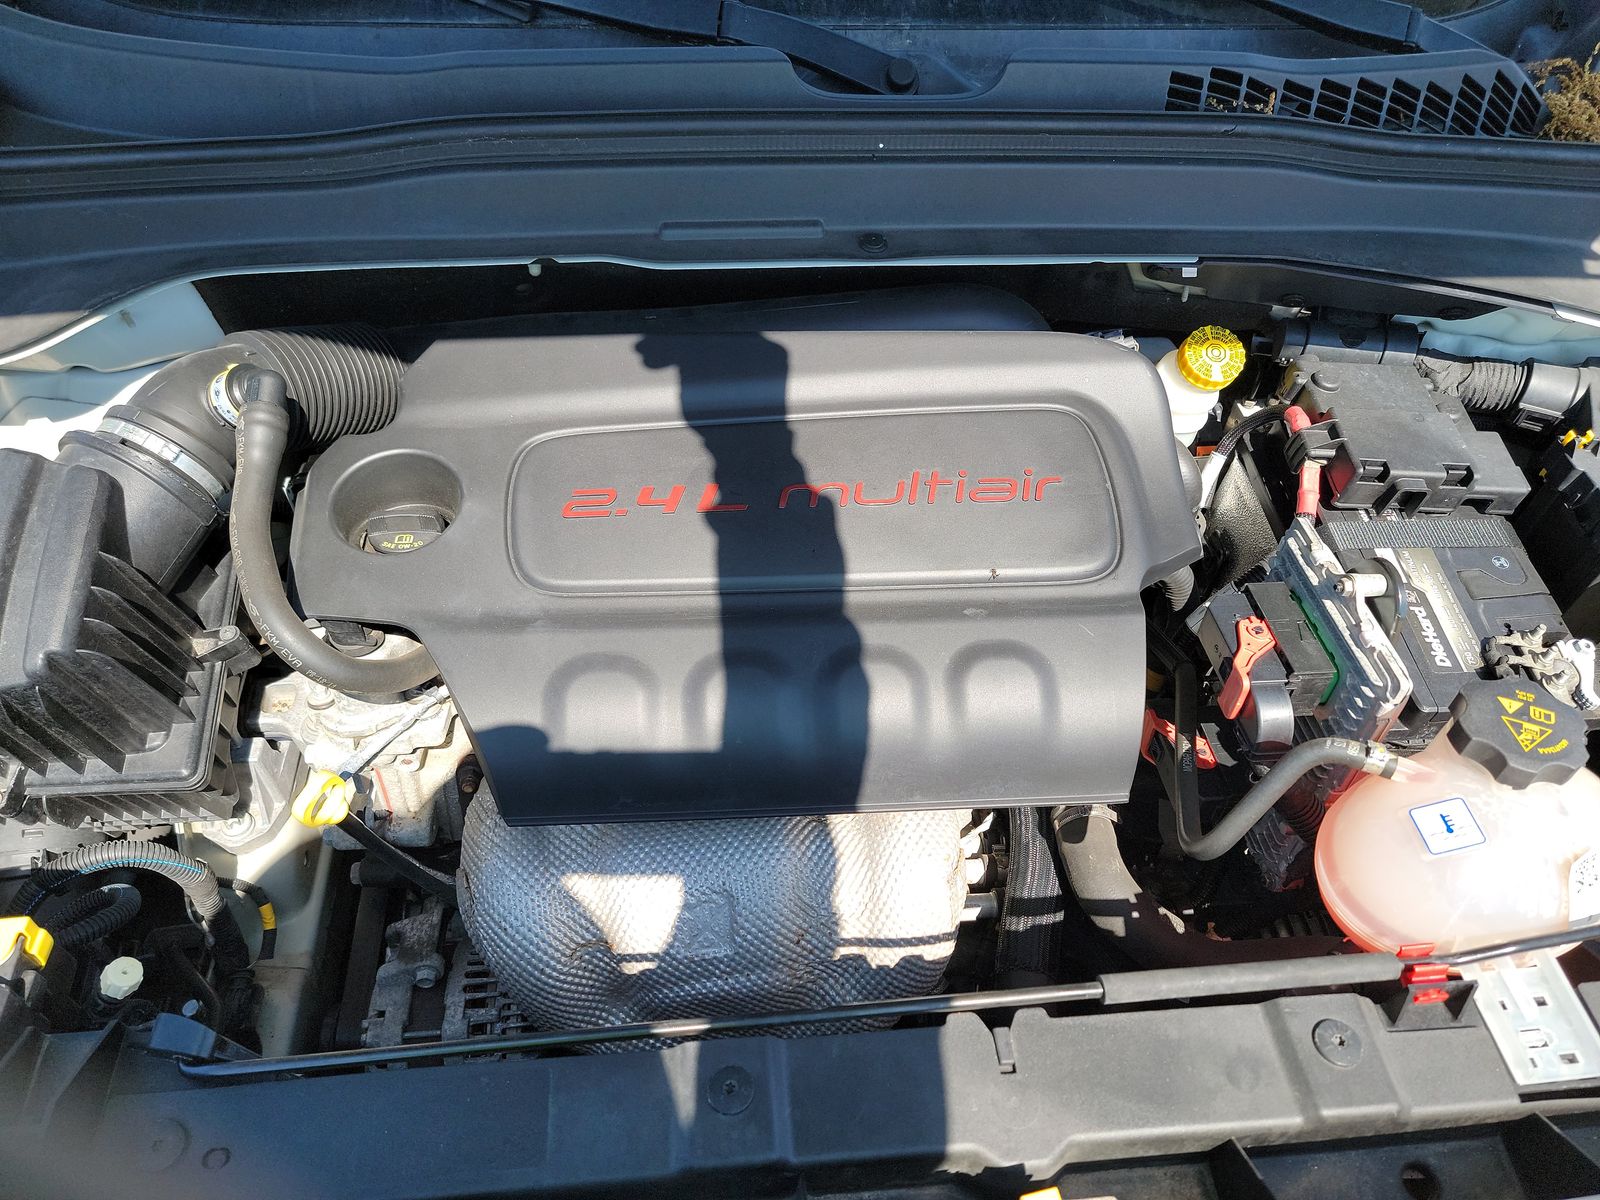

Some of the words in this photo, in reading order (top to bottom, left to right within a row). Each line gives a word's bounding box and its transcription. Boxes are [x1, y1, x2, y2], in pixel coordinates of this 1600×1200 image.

[778, 468, 1062, 508] multiair
[382, 541, 396, 550] SAE
[398, 540, 424, 550] 0W-20
[1409, 605, 1452, 667] DieHard
